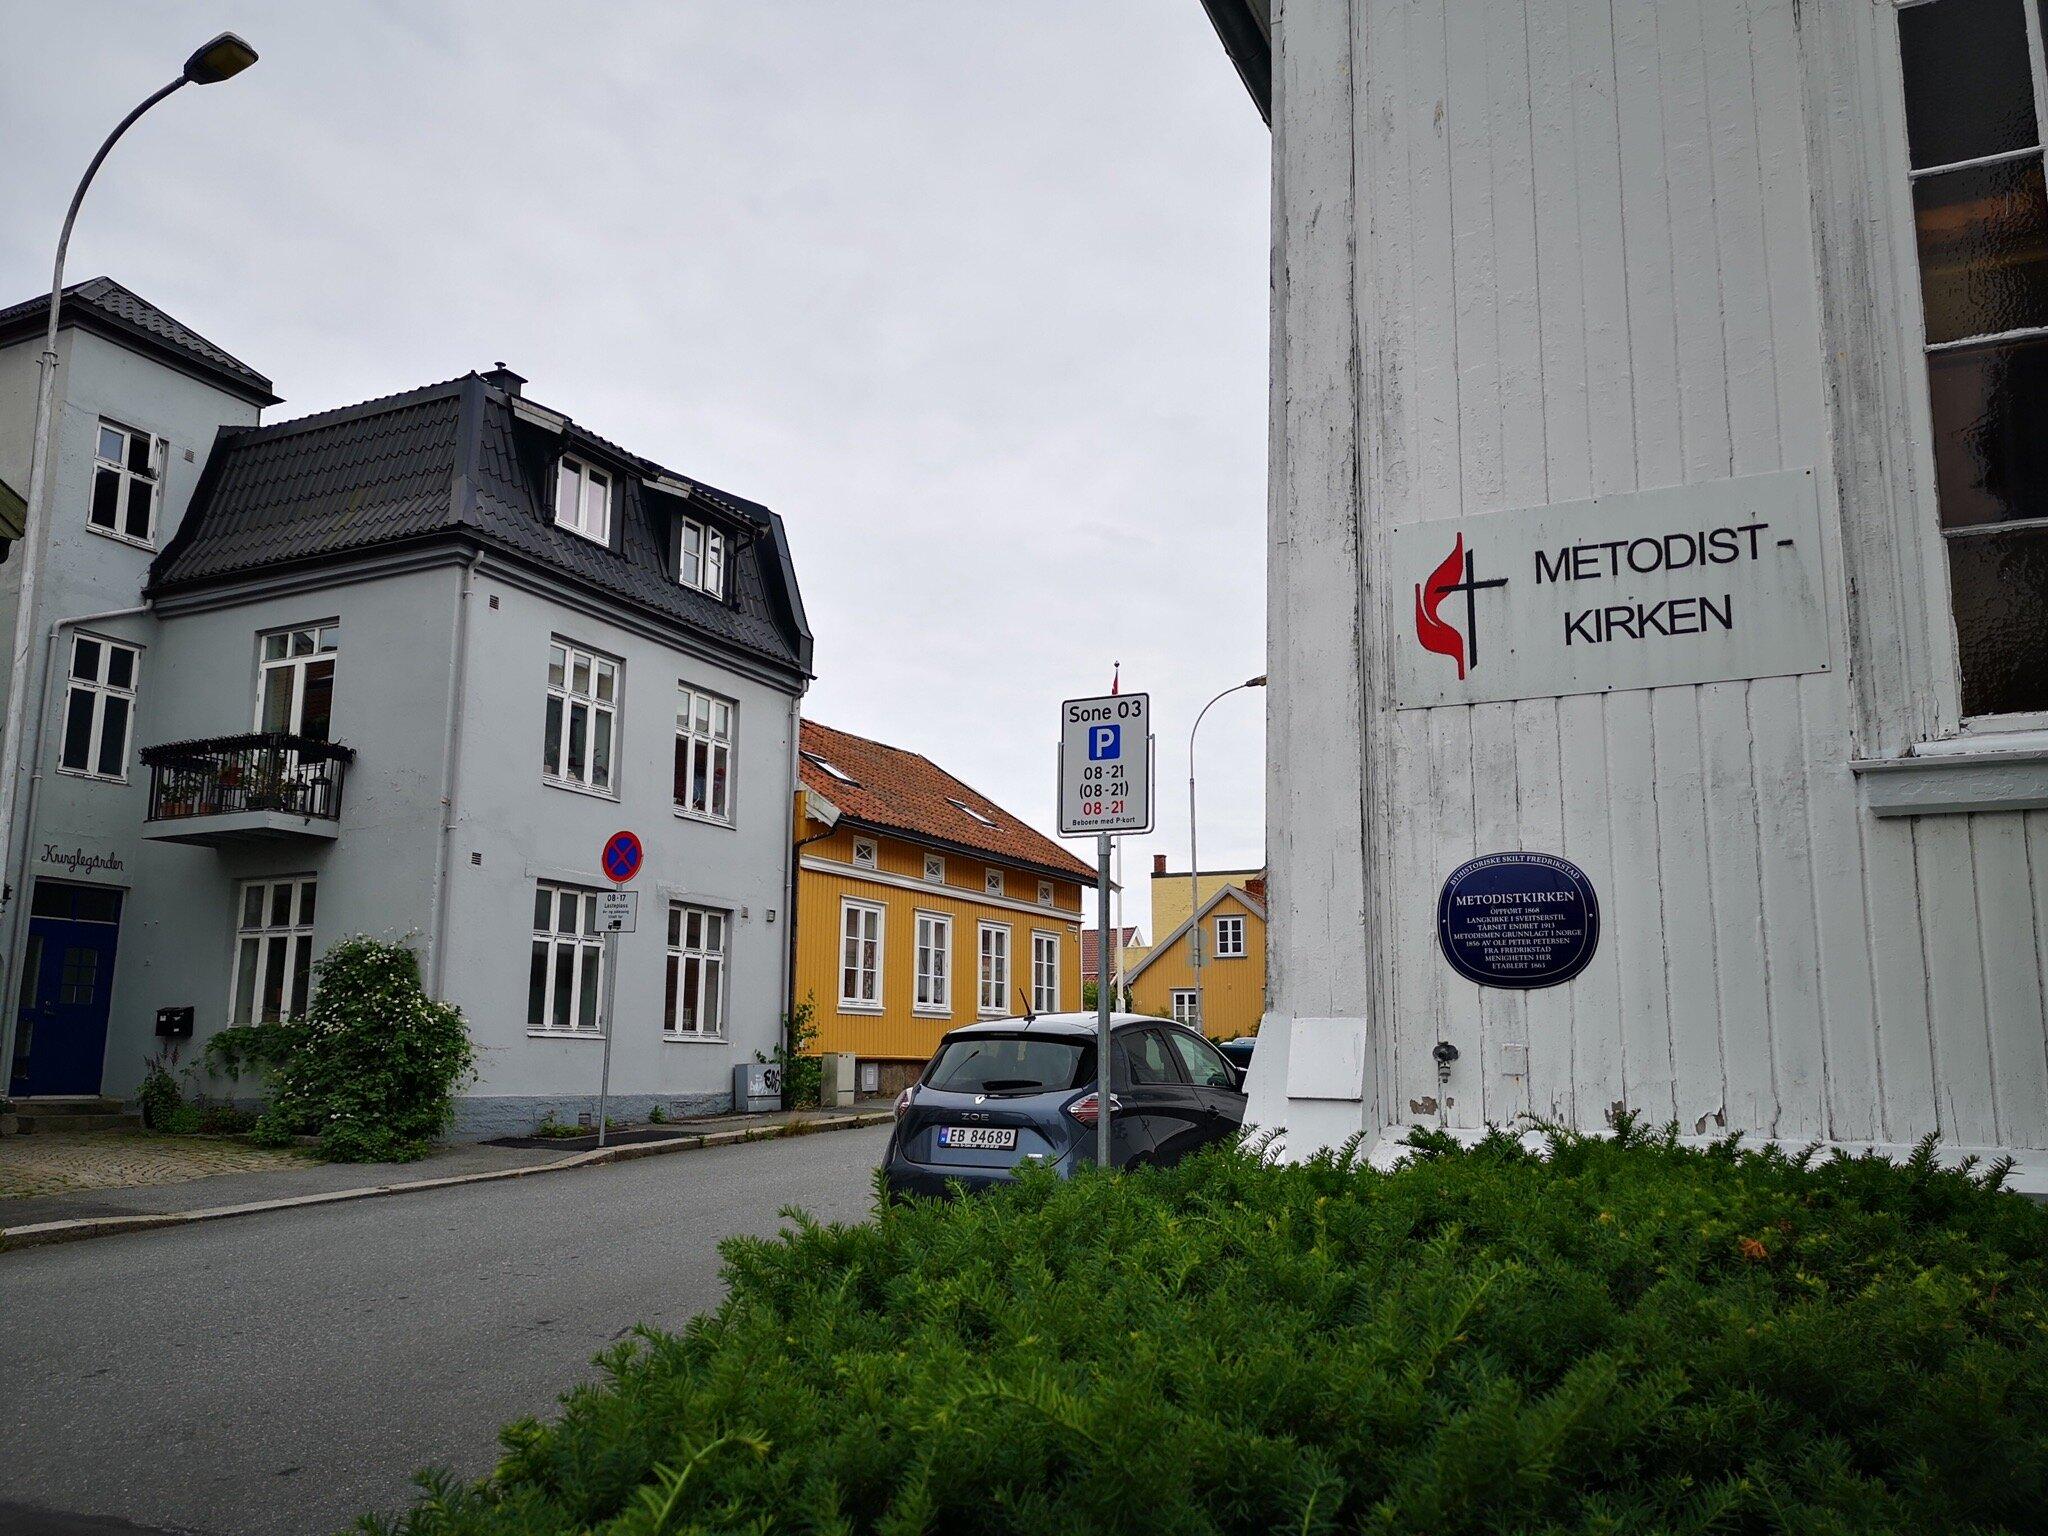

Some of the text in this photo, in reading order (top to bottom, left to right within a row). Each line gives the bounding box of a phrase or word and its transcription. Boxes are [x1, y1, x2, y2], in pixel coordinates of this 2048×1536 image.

[1564, 594, 1733, 646] KIRKEN
[1069, 700, 1142, 723] Sone 03
[1450, 855, 1580, 886] BYHISTORISKE SKILT FREDRIKSTAD
[1456, 891, 1576, 906] METODISTKIRKEN
[1466, 916, 1509, 924] LANGKIRKE
[1515, 914, 1566, 922] SVEITSERSTIL
[1477, 923, 1507, 931] TÅRNET
[1509, 922, 1539, 930] ENDRET
[1453, 932, 1500, 940] METODISMEN
[1502, 930, 1549, 938] GRUNNLAGT
[1509, 938, 1531, 946] PETER
[1533, 937, 1570, 945] PETERSEN
[1500, 946, 1552, 954] FREDRIKSTAD
[1485, 954, 1534, 962] MENIGHETEN
[961, 1112, 990, 1120] ZOE
[950, 1129, 1012, 1144] EB 84689
